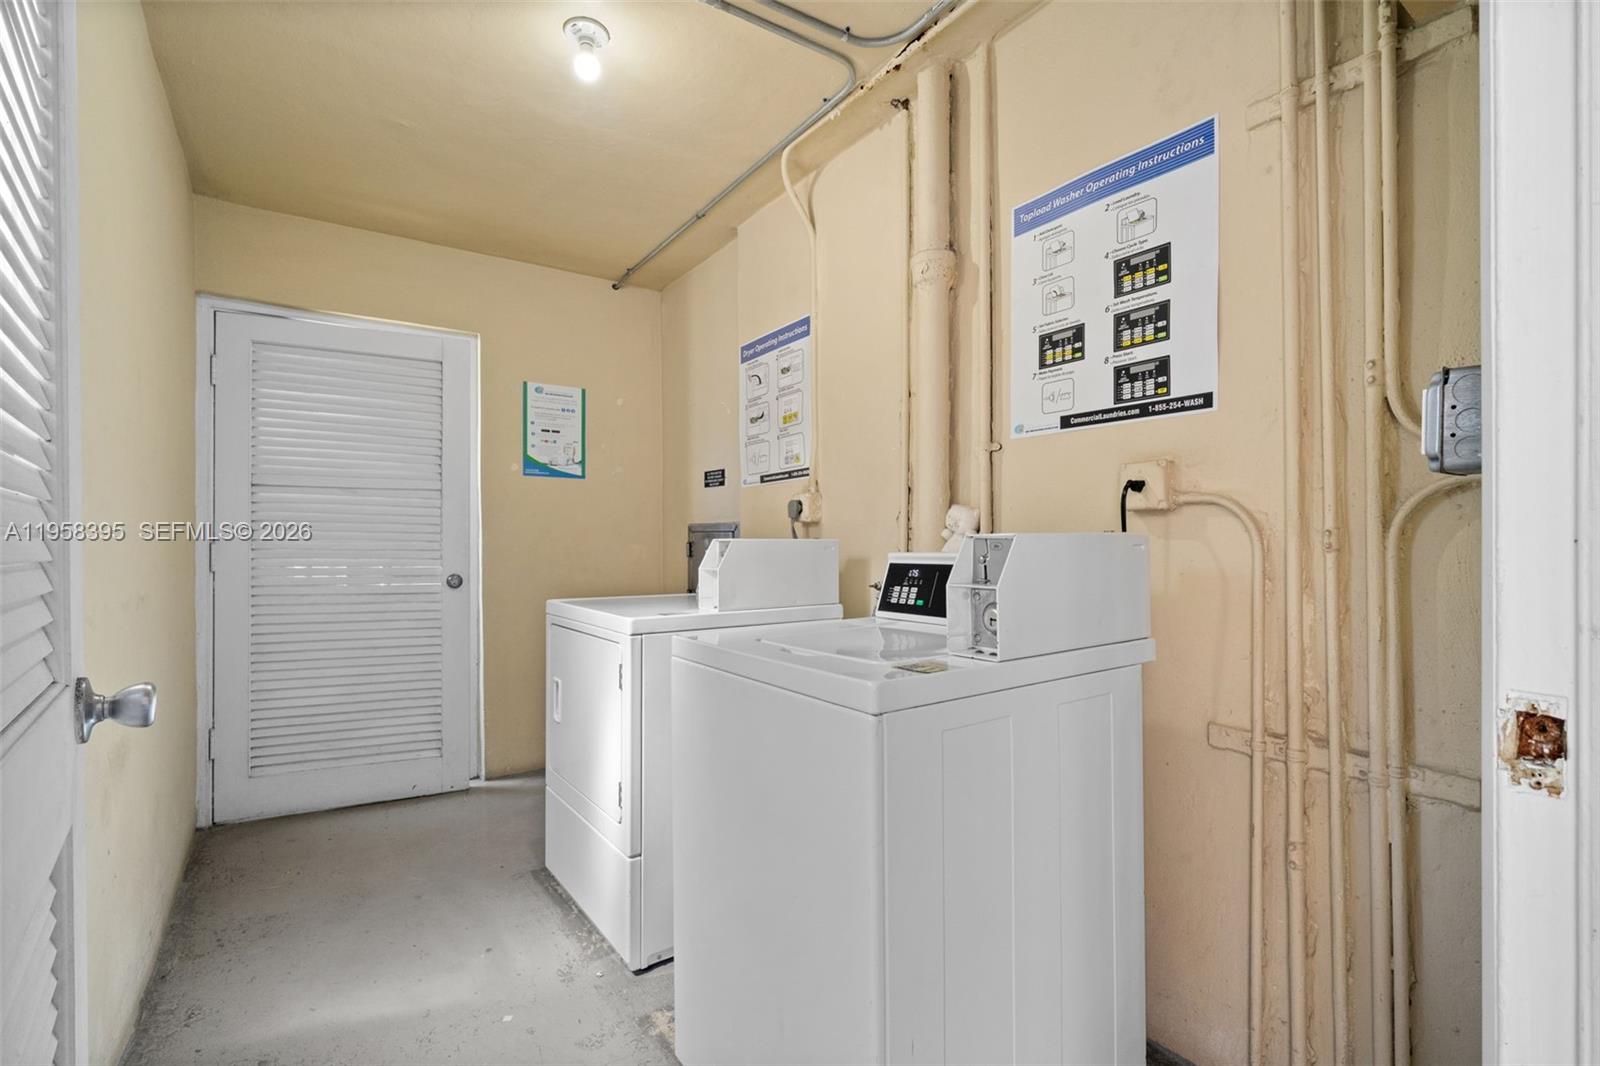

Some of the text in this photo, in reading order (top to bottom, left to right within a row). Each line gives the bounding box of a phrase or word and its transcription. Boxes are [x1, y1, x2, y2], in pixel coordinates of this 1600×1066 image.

[1020, 203, 1052, 223] Topload
[1052, 188, 1085, 208] Washer
[1085, 166, 1136, 192] Operating
[1137, 136, 1205, 171] Instructions
[1104, 203, 1110, 212] 2
[1104, 252, 1109, 260] 4
[1032, 278, 1037, 286] 3
[1105, 305, 1110, 313] 6
[1032, 326, 1037, 334] 5
[755, 337, 778, 352] Operating
[778, 325, 808, 341] Instructions
[1104, 357, 1109, 365] 8
[1032, 373, 1037, 381] 7
[1070, 398, 1204, 425] CommercialLaundries.com 1-855-254-WASH
